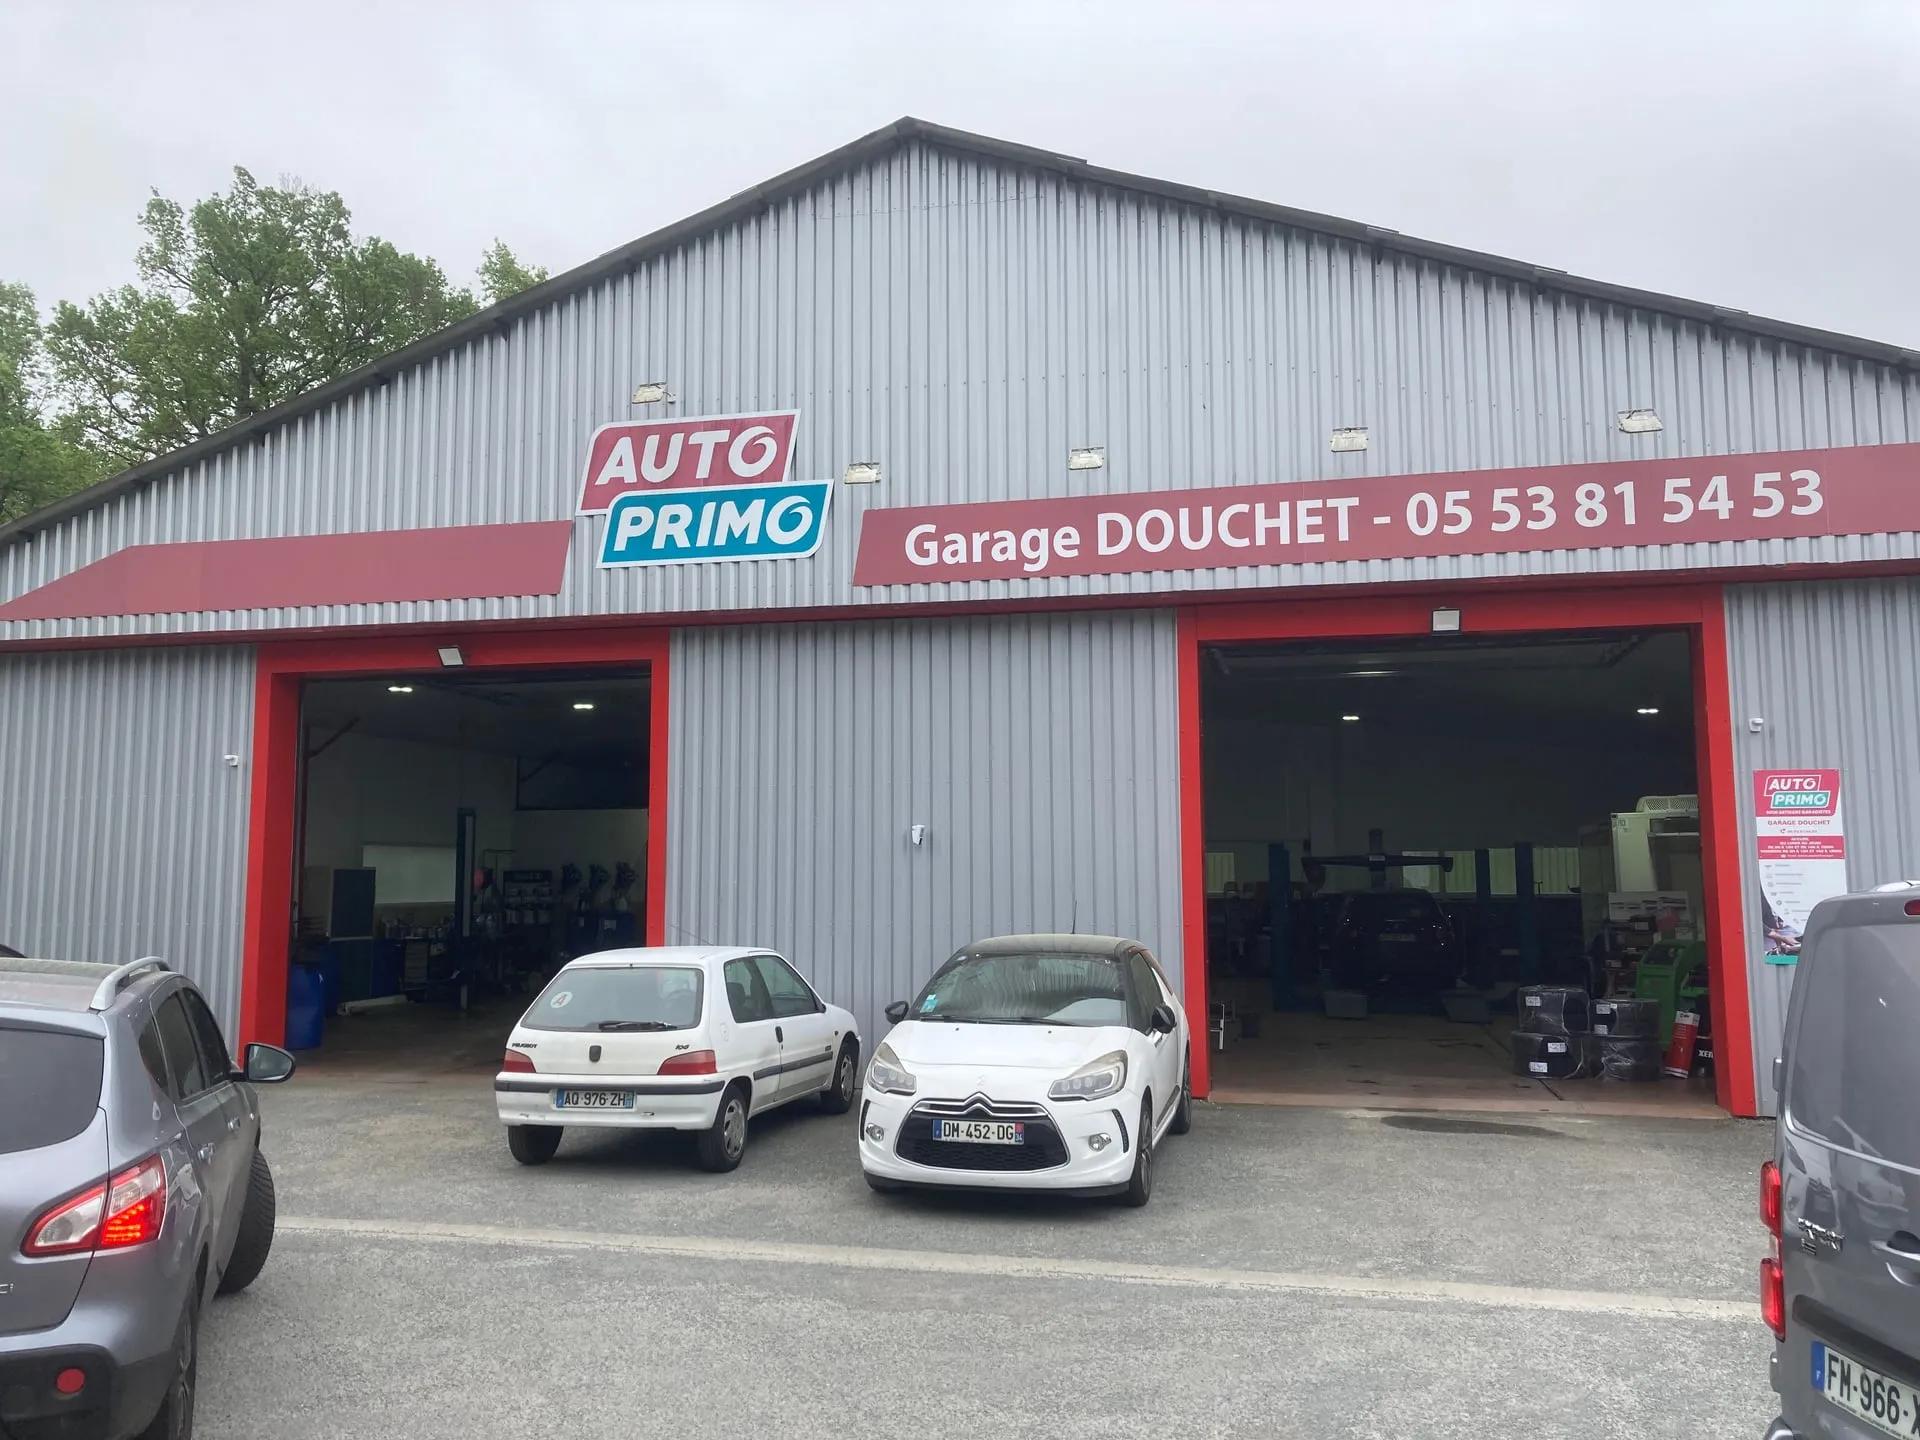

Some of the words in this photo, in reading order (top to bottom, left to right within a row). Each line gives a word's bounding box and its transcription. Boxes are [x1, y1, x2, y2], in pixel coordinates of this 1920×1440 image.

[594, 424, 778, 486] AUTO
[613, 495, 813, 551] PRIMO
[904, 522, 1081, 573] Garage
[1096, 495, 1361, 556] DOUCHET
[1373, 514, 1392, 525] -
[1405, 489, 1473, 537] 05
[1490, 485, 1560, 533] 53
[1573, 480, 1637, 528] 81
[1662, 473, 1736, 525] 54
[1750, 467, 1825, 519] 53
[1768, 777, 1816, 790] AUTO
[1774, 793, 1827, 806] PRIMO
